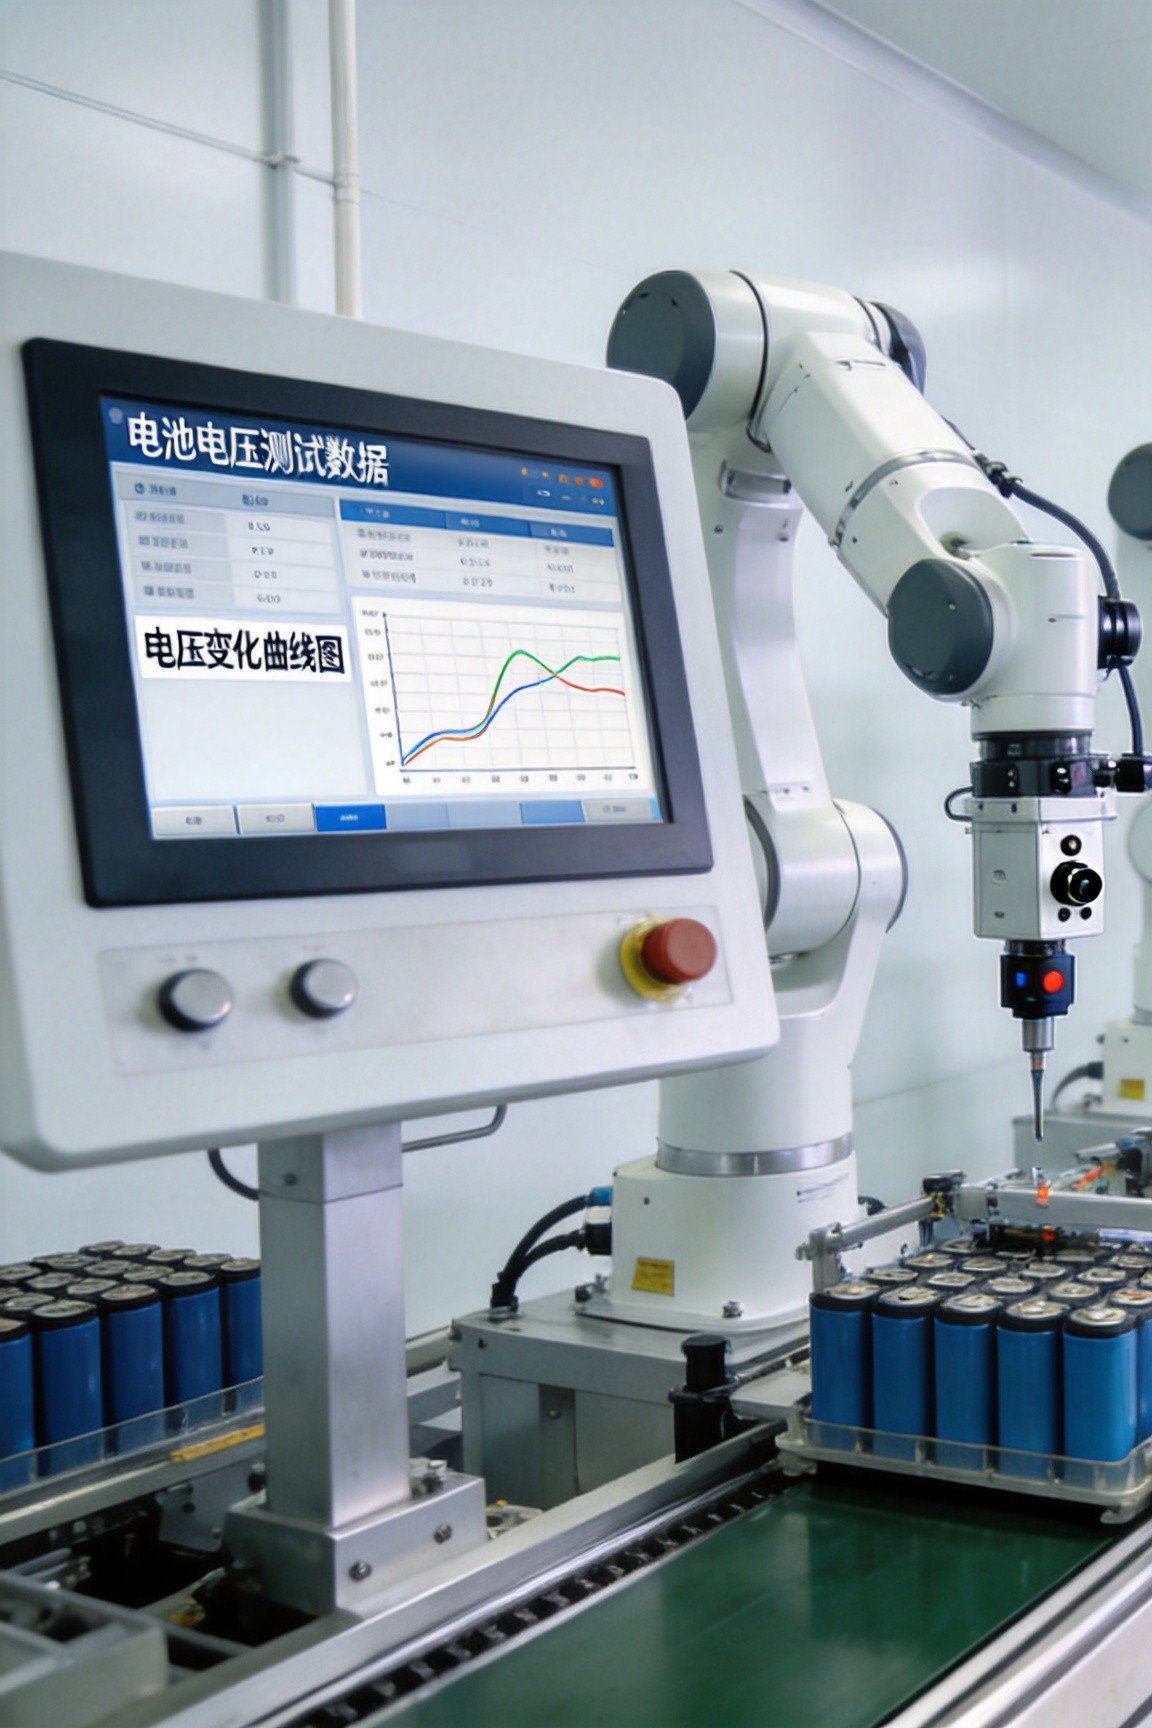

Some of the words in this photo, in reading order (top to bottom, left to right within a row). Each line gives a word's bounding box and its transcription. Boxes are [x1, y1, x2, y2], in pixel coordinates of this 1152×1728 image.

[127, 412, 389, 486] 电池电压测试数据
[145, 626, 345, 674] 电压变化曲线图
